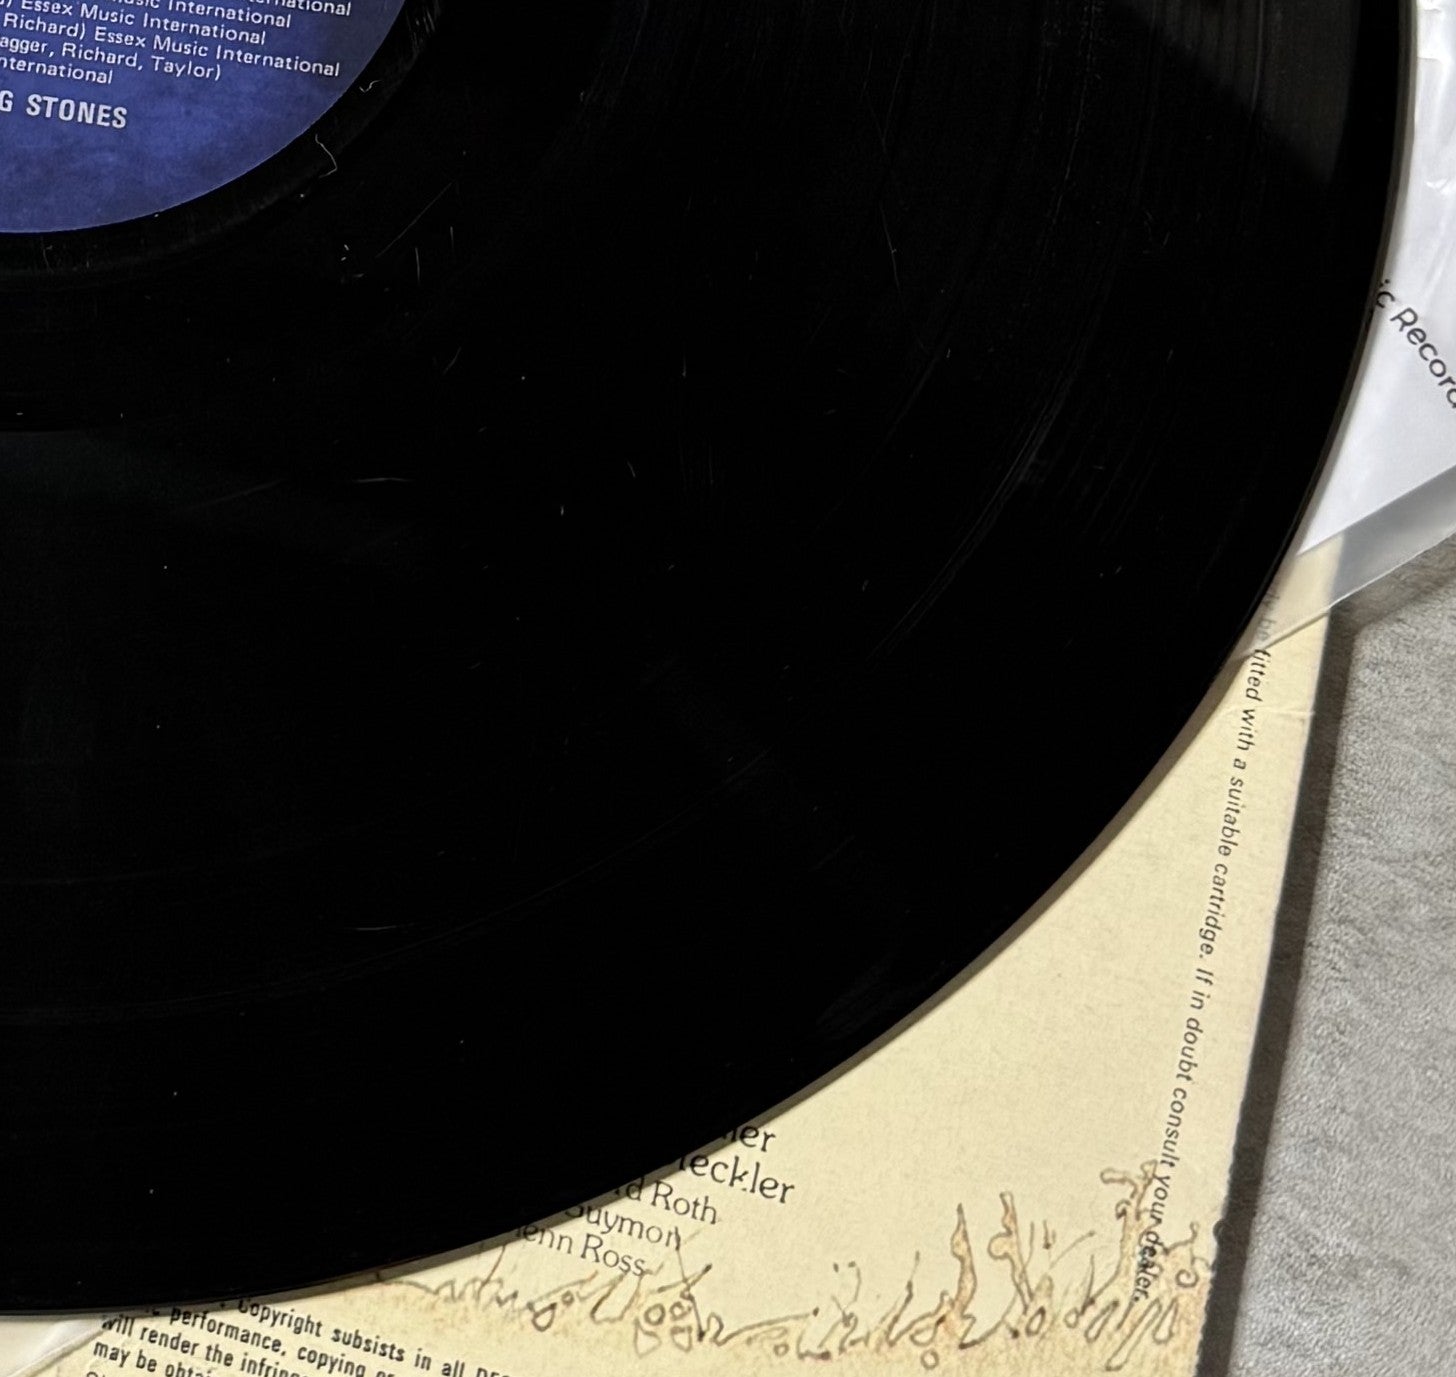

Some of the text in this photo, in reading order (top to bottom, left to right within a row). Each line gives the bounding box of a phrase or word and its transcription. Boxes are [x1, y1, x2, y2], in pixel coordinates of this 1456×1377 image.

[3, 13, 85, 40] Richard)
[95, 26, 146, 47] Essex
[154, 35, 208, 56] Music
[216, 45, 339, 76] International
[81, 3, 135, 25] Music
[143, 13, 265, 45] International
[62, 42, 142, 70] Richard,
[151, 55, 220, 80] Taylor)
[26, 94, 127, 128] STONES
[1235, 709, 1259, 752] with
[1233, 758, 1247, 770] a
[1217, 776, 1245, 857] suitable
[1199, 862, 1228, 959] cartridge.
[1195, 967, 1214, 987] If
[1190, 988, 1211, 1011] in
[1175, 1016, 1204, 1082] doubt
[1159, 1087, 1187, 1168] consult
[650, 1179, 718, 1225] Roth
[1149, 1174, 1172, 1226] your
[579, 1233, 646, 1277] Ross
[139, 1326, 199, 1356] render
[204, 1343, 234, 1367] the
[169, 1306, 287, 1357] performance,
[331, 1327, 405, 1362] subsists
[413, 1348, 432, 1371] in
[93, 1341, 158, 1373] may be
